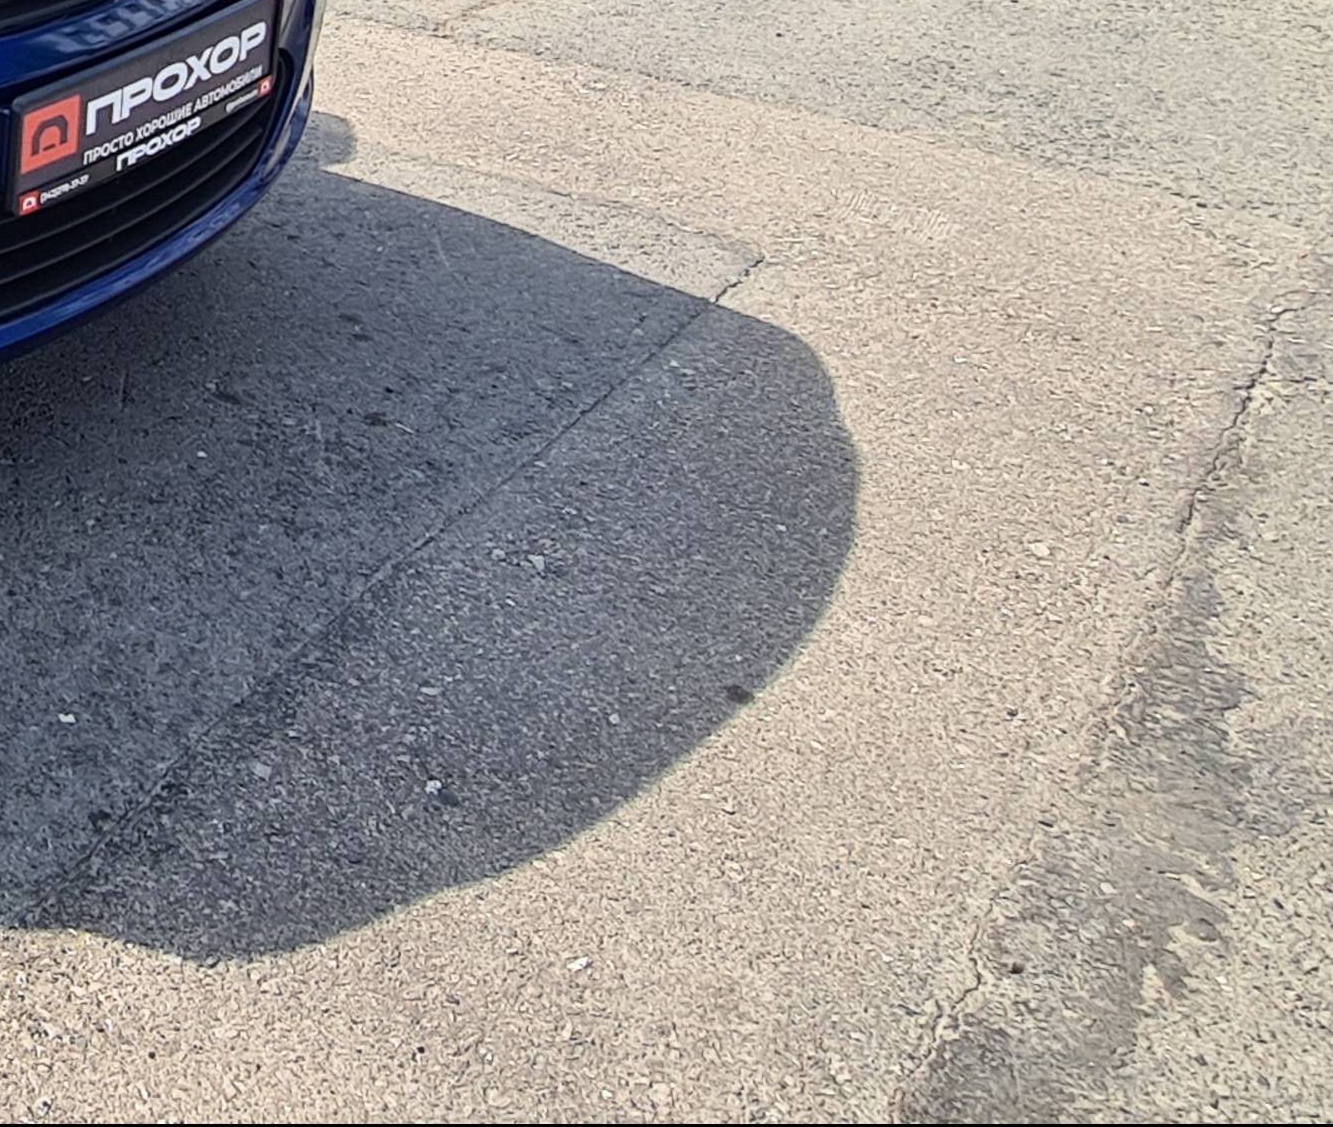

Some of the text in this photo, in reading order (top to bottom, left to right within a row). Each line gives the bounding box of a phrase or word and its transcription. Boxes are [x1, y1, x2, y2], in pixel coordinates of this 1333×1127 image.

[85, 21, 267, 136] ПРОХОР
[83, 131, 134, 165] ПРОСТО
[134, 102, 192, 142] ХОРОШИЕ
[115, 116, 201, 172] ПРОХОР
